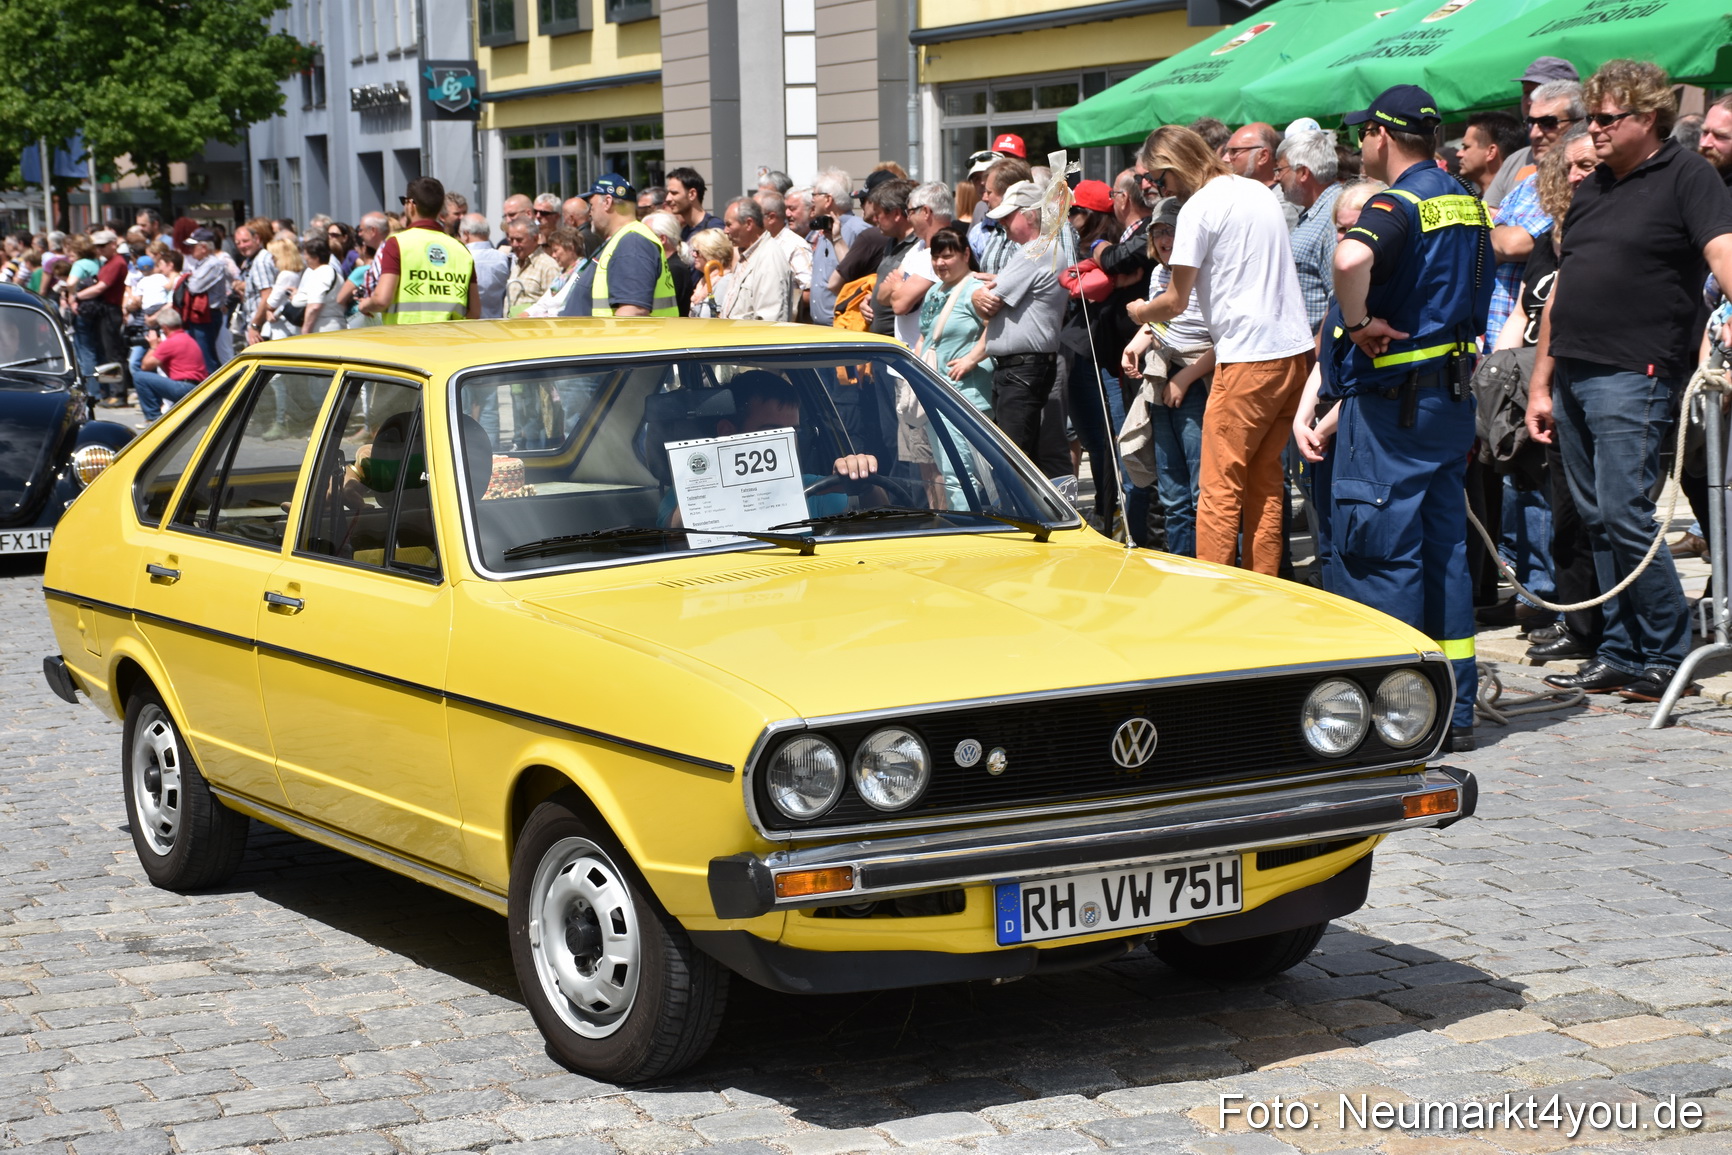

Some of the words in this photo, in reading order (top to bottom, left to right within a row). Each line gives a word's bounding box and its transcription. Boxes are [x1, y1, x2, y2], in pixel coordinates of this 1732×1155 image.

[409, 269, 467, 284] FOLLOW
[429, 284, 451, 296] ME
[734, 448, 778, 476] 529
[0, 532, 51, 551] FX1H
[1022, 882, 1076, 934] RH
[1101, 872, 1153, 922] VW
[1164, 859, 1239, 914] 75H
[1005, 920, 1014, 933] D
